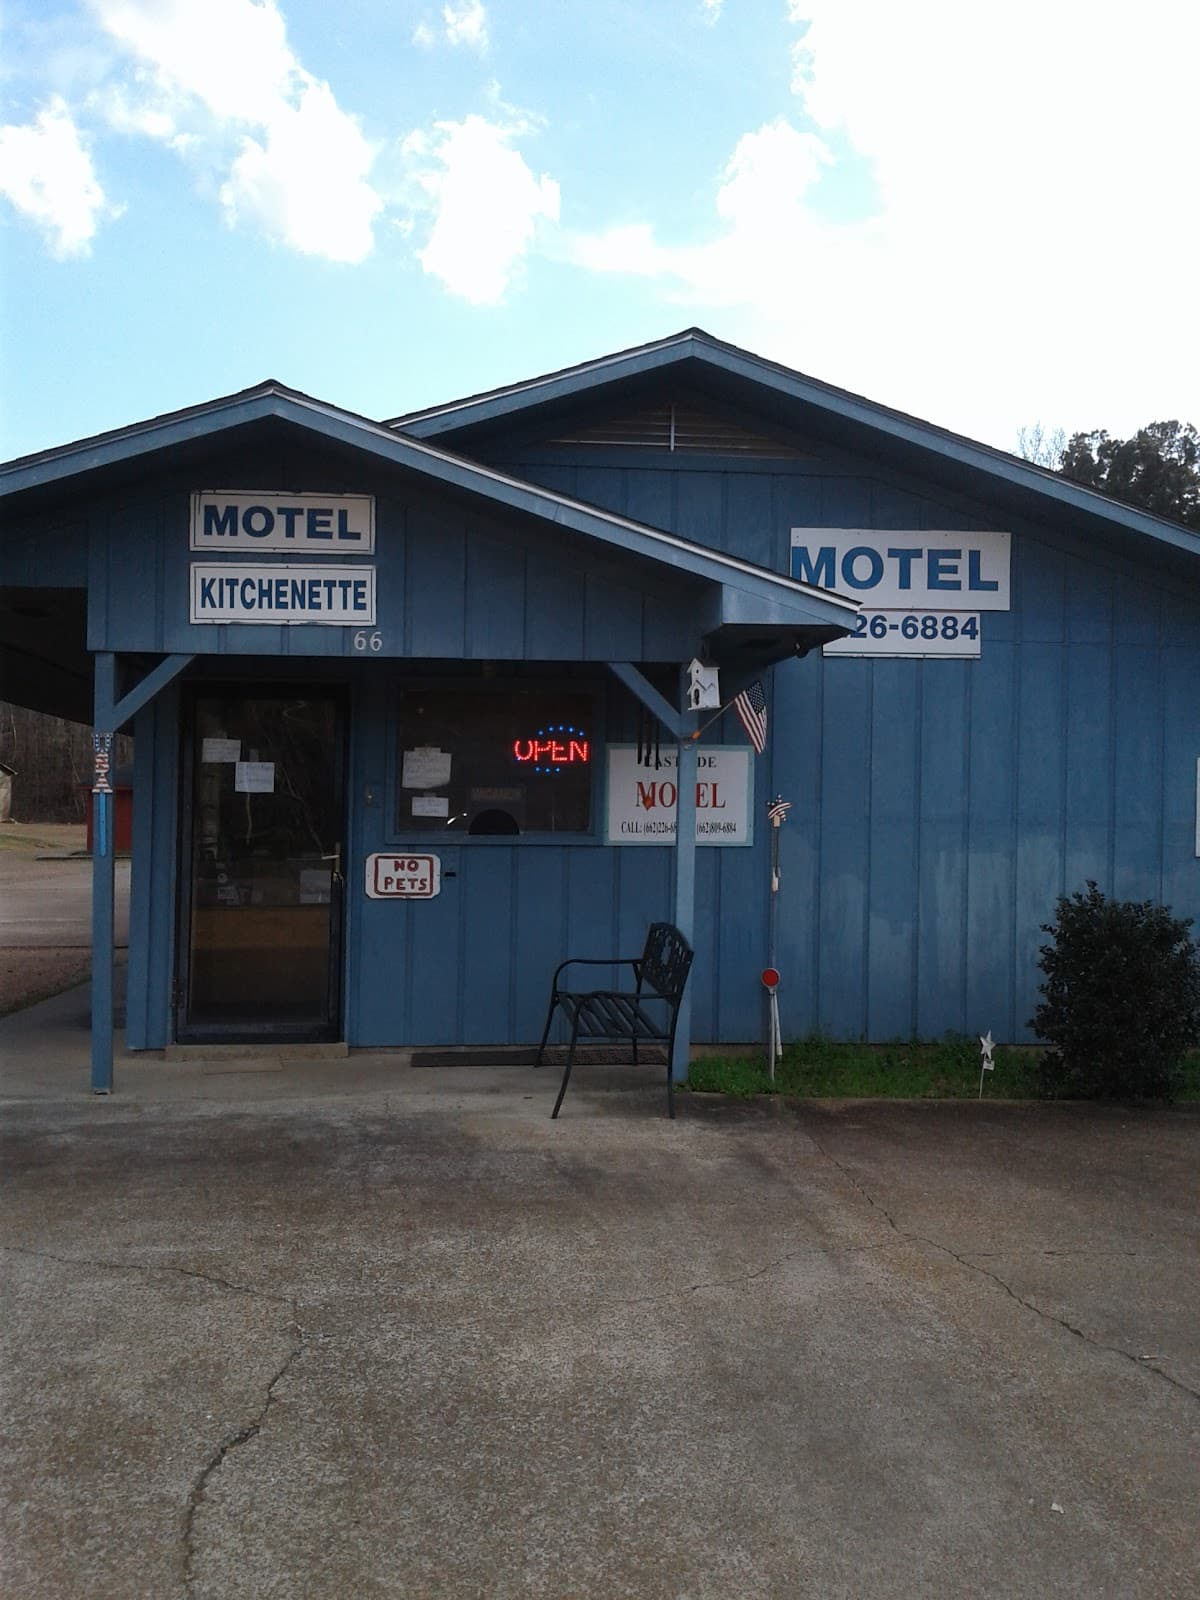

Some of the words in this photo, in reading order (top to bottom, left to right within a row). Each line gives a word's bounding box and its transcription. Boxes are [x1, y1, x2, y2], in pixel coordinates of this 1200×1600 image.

[204, 505, 361, 540] MOTEL
[791, 546, 998, 591] MOTEL
[201, 577, 367, 610] KITCHENETTE
[850, 615, 978, 640] 26-6884
[354, 631, 383, 651] 66
[514, 740, 589, 762] OPEN
[635, 781, 726, 808] MOEL
[621, 821, 642, 833] CALL:
[394, 860, 419, 872] NO
[384, 876, 427, 890] PETS
